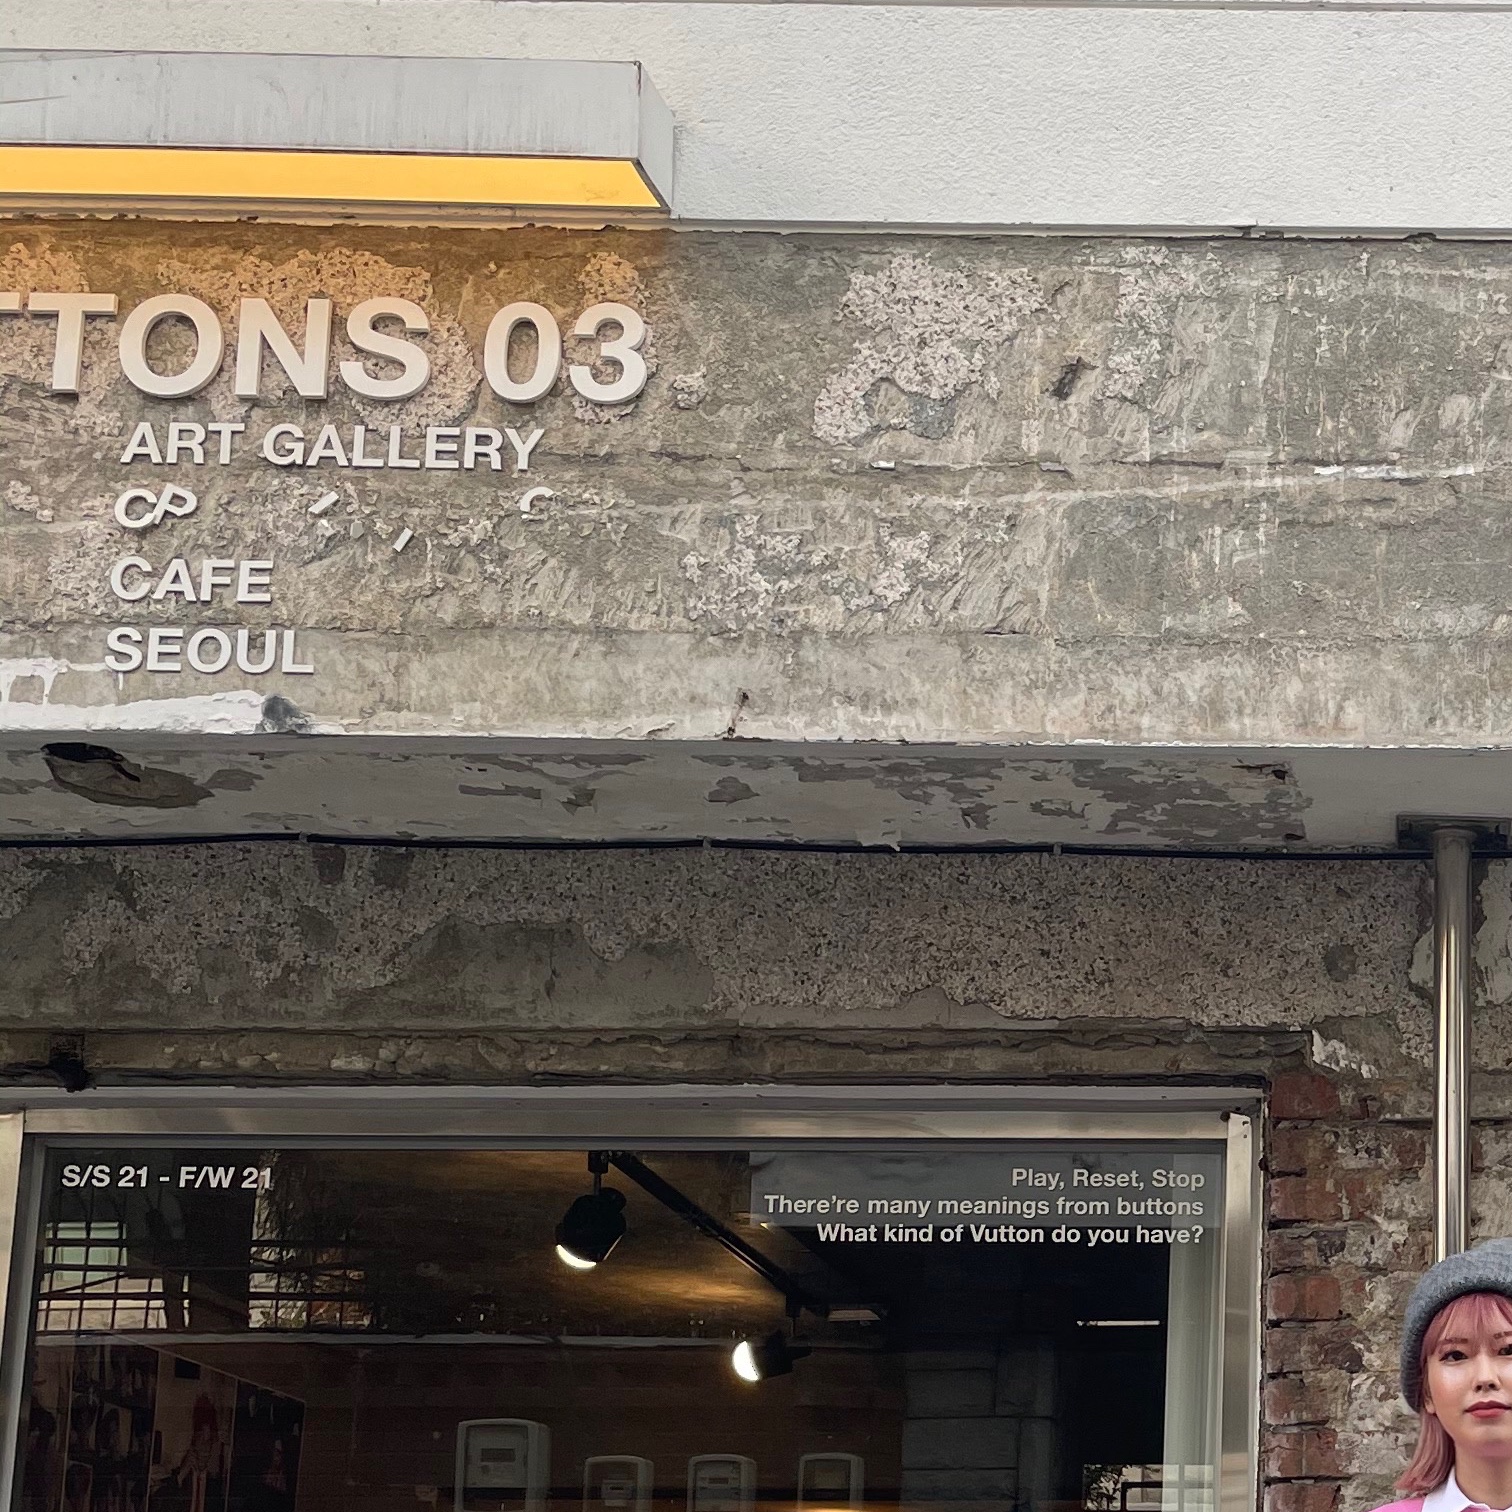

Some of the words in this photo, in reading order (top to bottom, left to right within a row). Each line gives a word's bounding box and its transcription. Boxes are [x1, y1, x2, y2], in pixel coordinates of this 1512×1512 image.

[0, 293, 431, 399] TONS
[484, 302, 647, 403] 03
[120, 422, 245, 464] ART
[262, 423, 546, 471] GALLERY
[111, 557, 275, 603] CAFE
[105, 627, 315, 675] SEOUL
[62, 1165, 110, 1187] S/S
[118, 1166, 148, 1187] 21
[179, 1167, 235, 1189] F/W
[241, 1167, 272, 1189] 21
[1012, 1168, 1065, 1191] Play,
[1072, 1170, 1145, 1191] Reset,
[1152, 1169, 1205, 1192] Stop
[868, 1199, 930, 1218] many
[937, 1197, 1050, 1217] meanings
[1056, 1197, 1109, 1216] from
[1117, 1198, 1204, 1217] buttons
[817, 1224, 877, 1243] What
[885, 1224, 935, 1243] kind
[940, 1224, 964, 1243] of
[970, 1225, 1044, 1243] Vutton
[1052, 1225, 1082, 1243] do
[1088, 1230, 1129, 1246] you
[1136, 1225, 1204, 1244] have?
